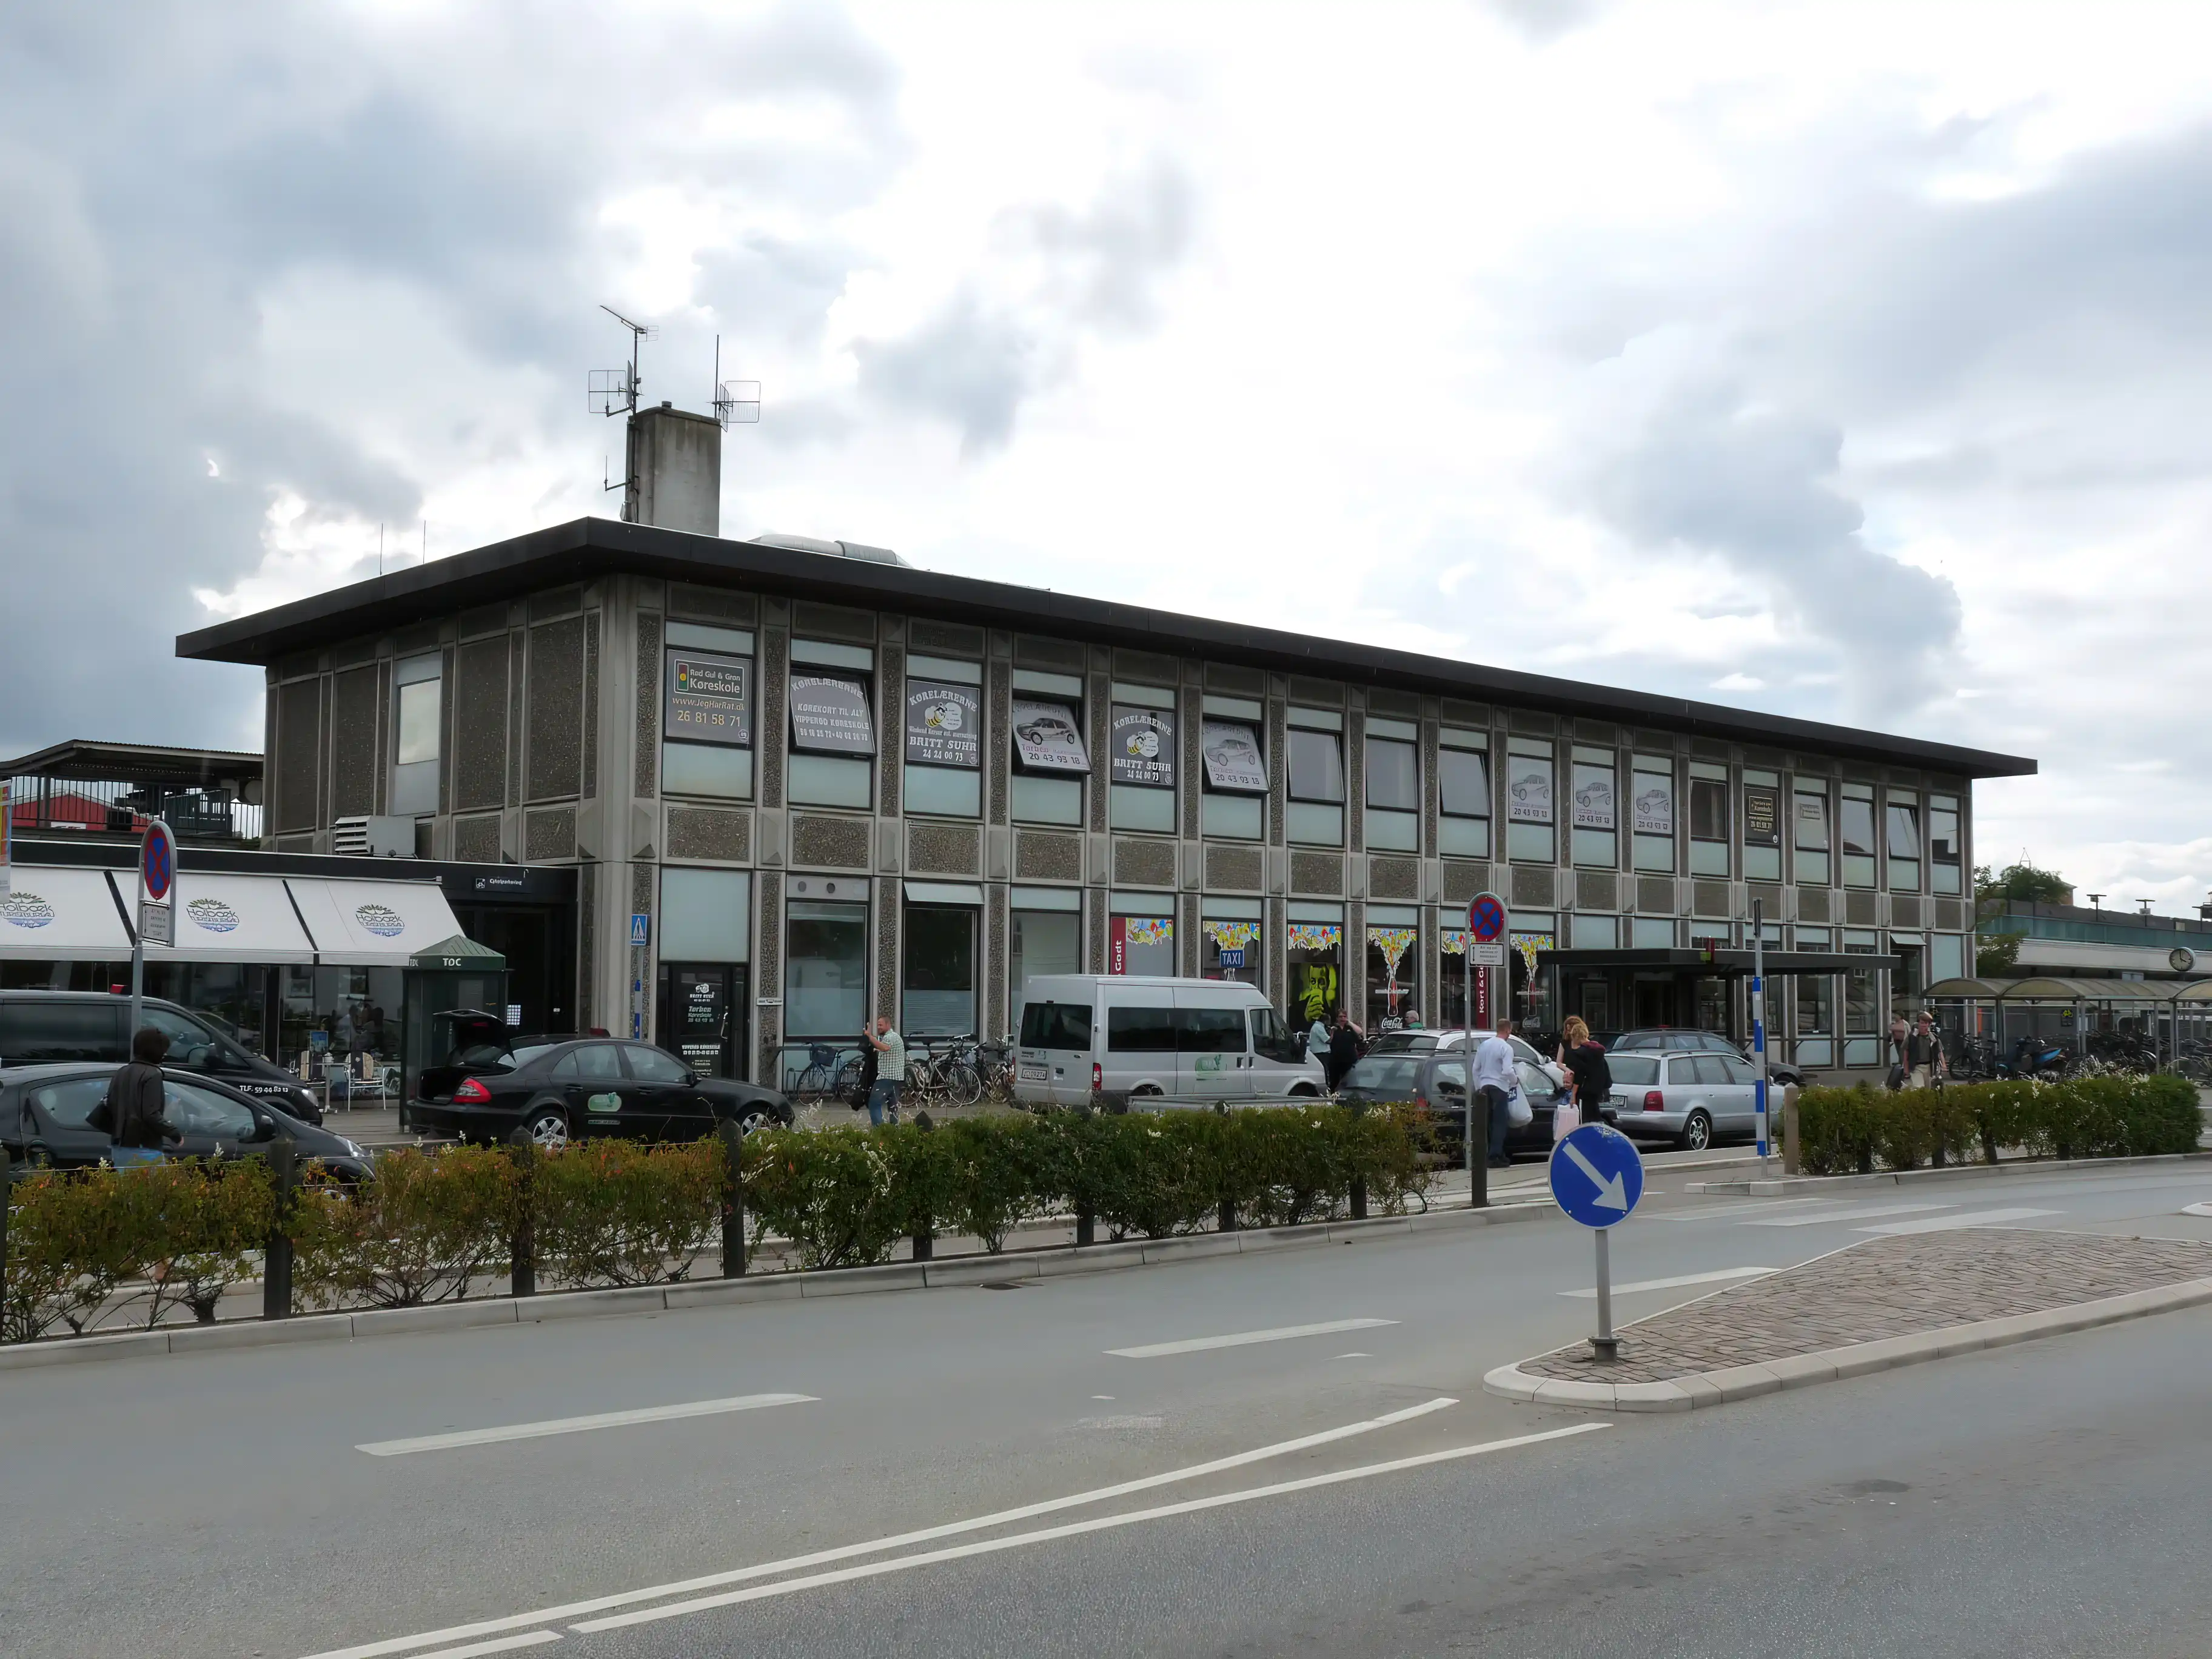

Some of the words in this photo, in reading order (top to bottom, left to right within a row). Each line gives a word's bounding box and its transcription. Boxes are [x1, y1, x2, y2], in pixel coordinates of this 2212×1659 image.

[690, 678, 740, 693] Køreskole
[677, 710, 690, 722] 26
[695, 712, 707, 723] 81
[712, 714, 725, 725] 58
[729, 716, 740, 727] 71
[910, 736, 943, 748] BRITT
[947, 740, 977, 751] SUHR
[955, 752, 963, 762] 73
[1114, 758, 1143, 769] BRITT
[1146, 762, 1171, 772] SUHR
[1222, 952, 1241, 964] TAXI
